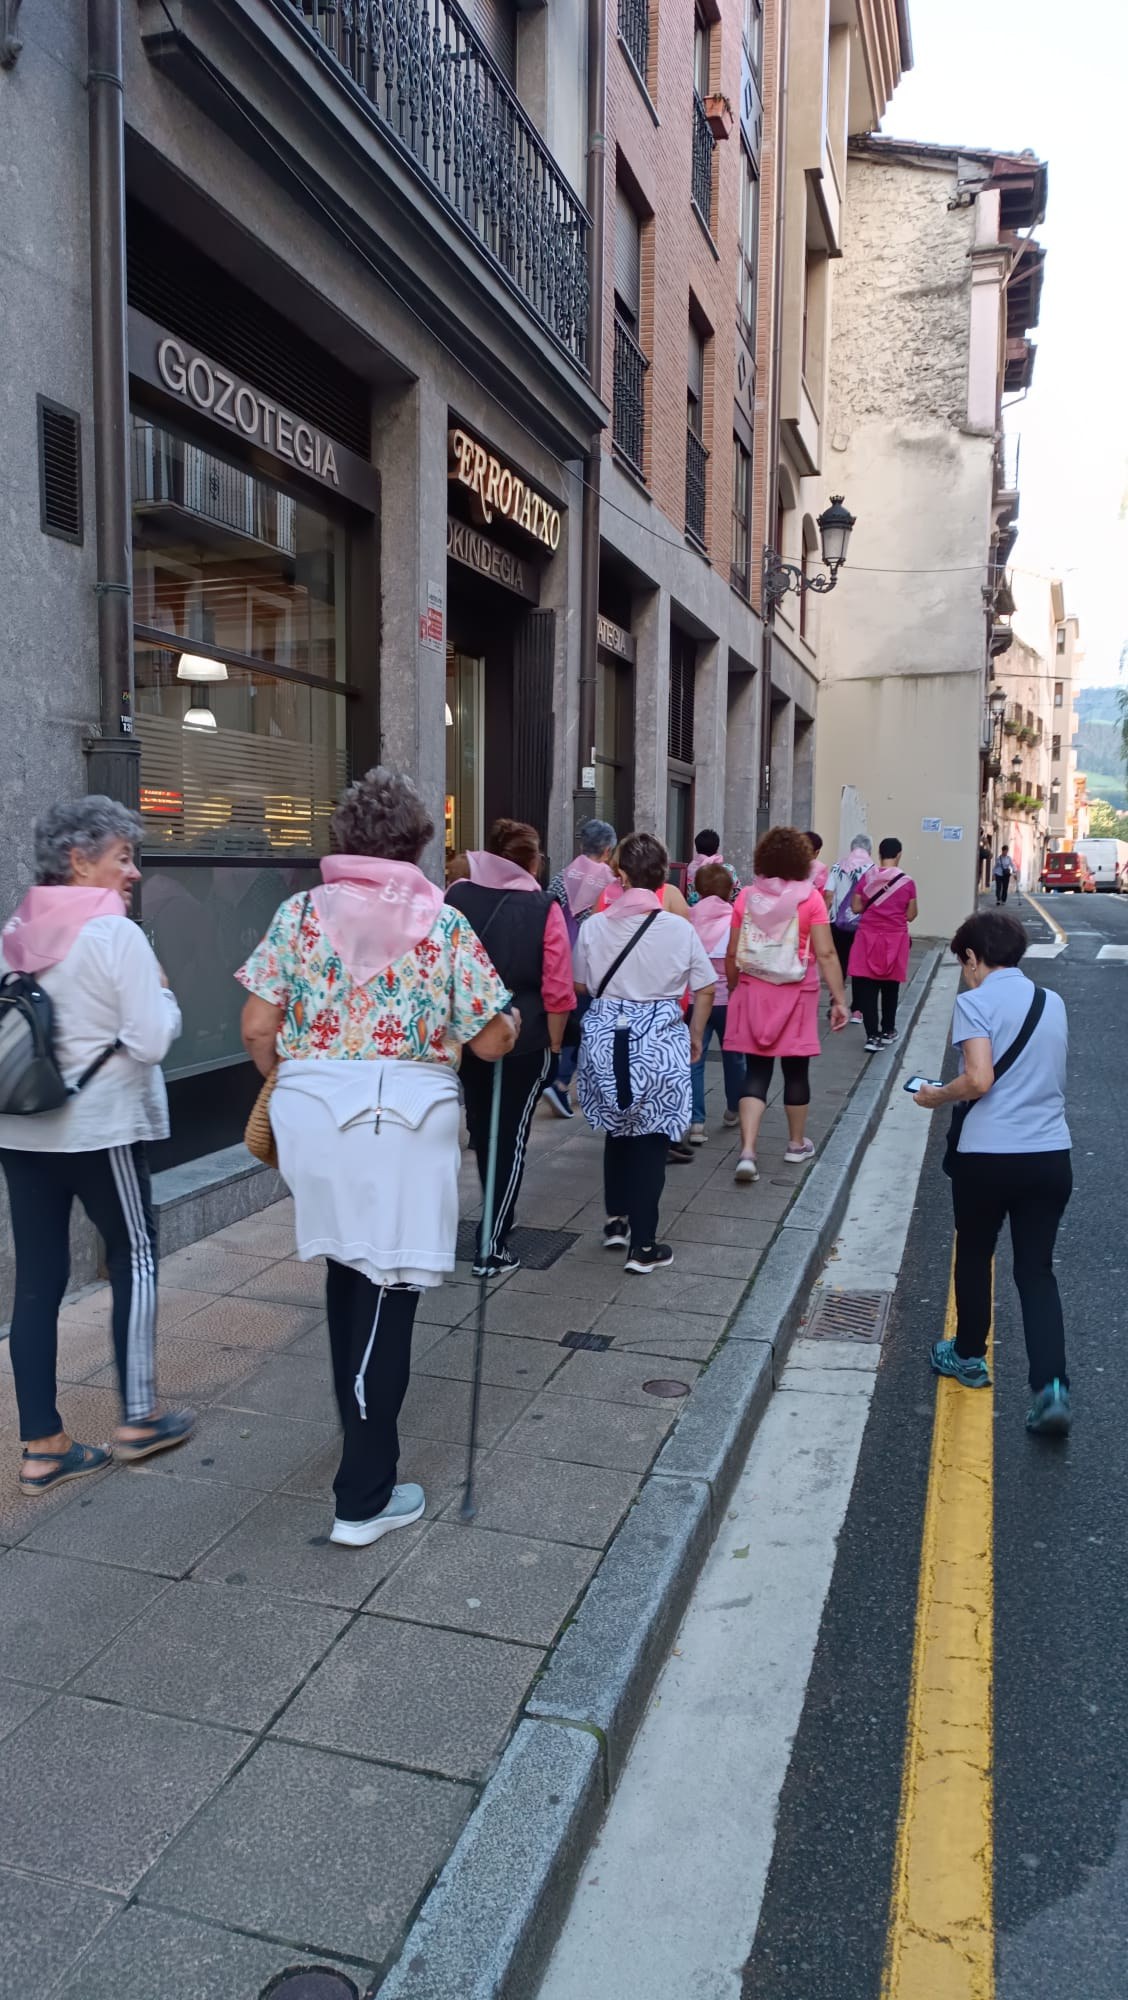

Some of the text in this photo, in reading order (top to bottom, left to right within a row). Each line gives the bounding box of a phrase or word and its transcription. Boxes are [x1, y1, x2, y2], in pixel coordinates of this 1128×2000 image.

[158, 339, 340, 485] GOZOTEGIA
[453, 428, 561, 550] ERROTATXO
[597, 616, 626, 655] ATEGIA
